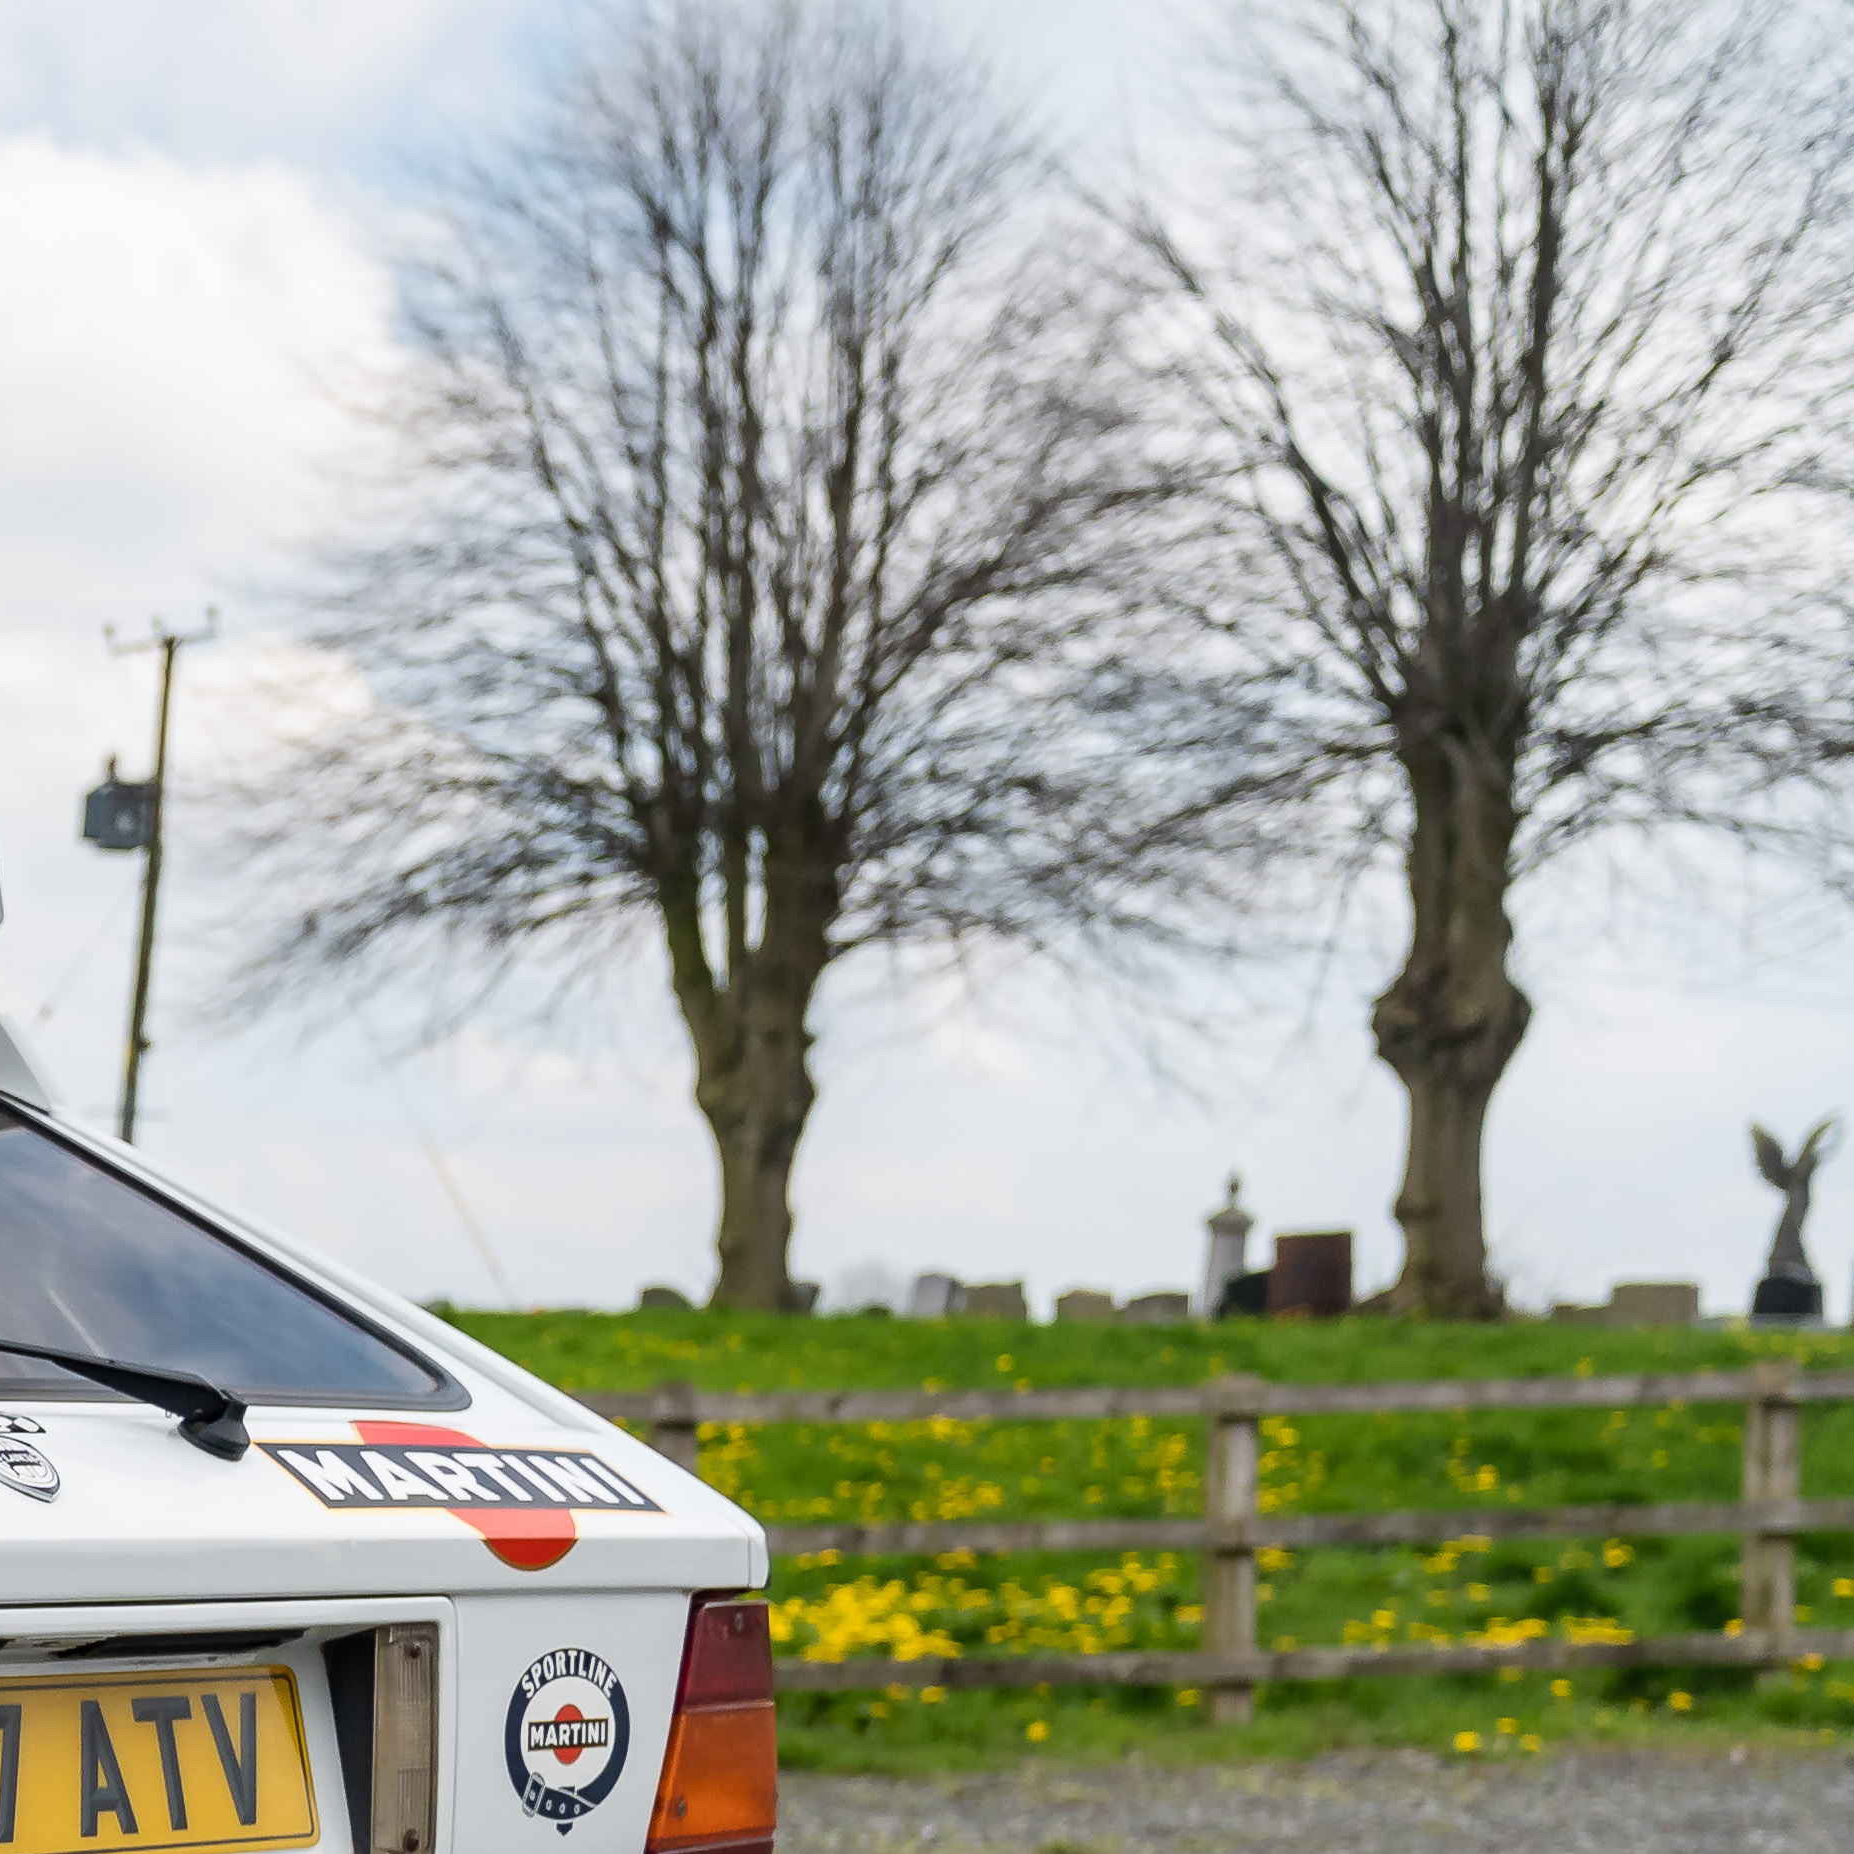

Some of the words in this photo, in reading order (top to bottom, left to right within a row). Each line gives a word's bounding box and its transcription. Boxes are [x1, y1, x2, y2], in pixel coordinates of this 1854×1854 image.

[277, 1449, 646, 1506] MARTINI
[522, 1649, 618, 1699] SPORTLINE
[530, 1721, 607, 1748] MARTINI
[80, 1691, 258, 1839] ATV
